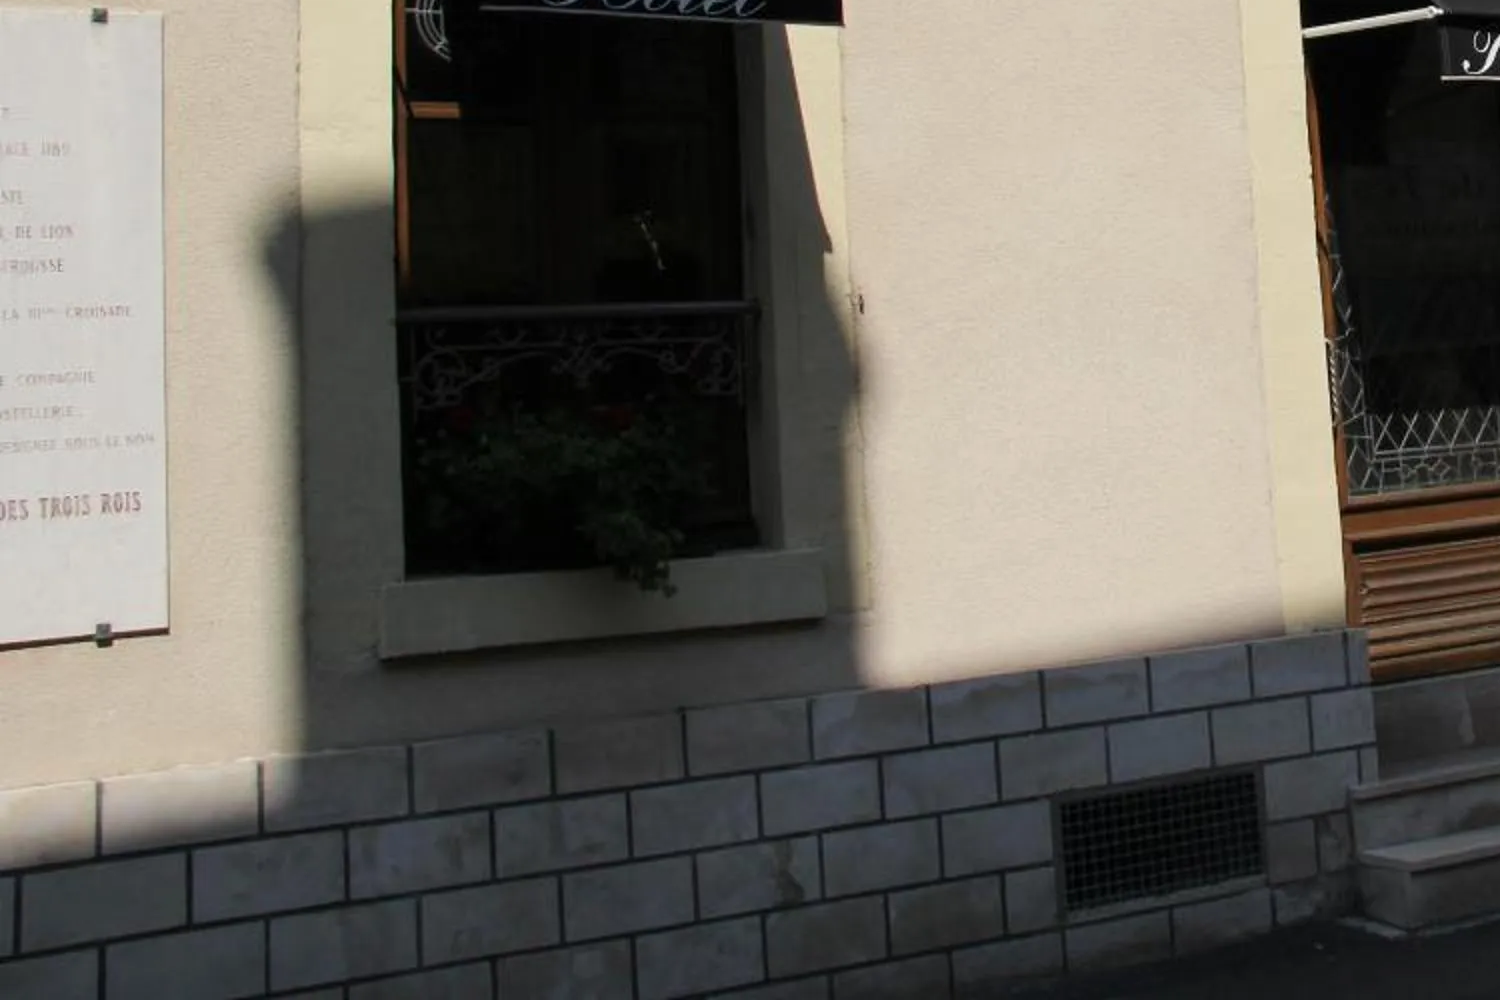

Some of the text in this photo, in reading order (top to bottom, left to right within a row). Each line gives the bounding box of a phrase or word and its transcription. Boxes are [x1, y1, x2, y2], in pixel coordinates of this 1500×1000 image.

[40, 223, 75, 239] LION
[65, 304, 132, 320] CROISADE
[15, 370, 97, 388] COMPAGNIE
[37, 492, 91, 520] TROIS
[99, 489, 143, 516] ROIS
